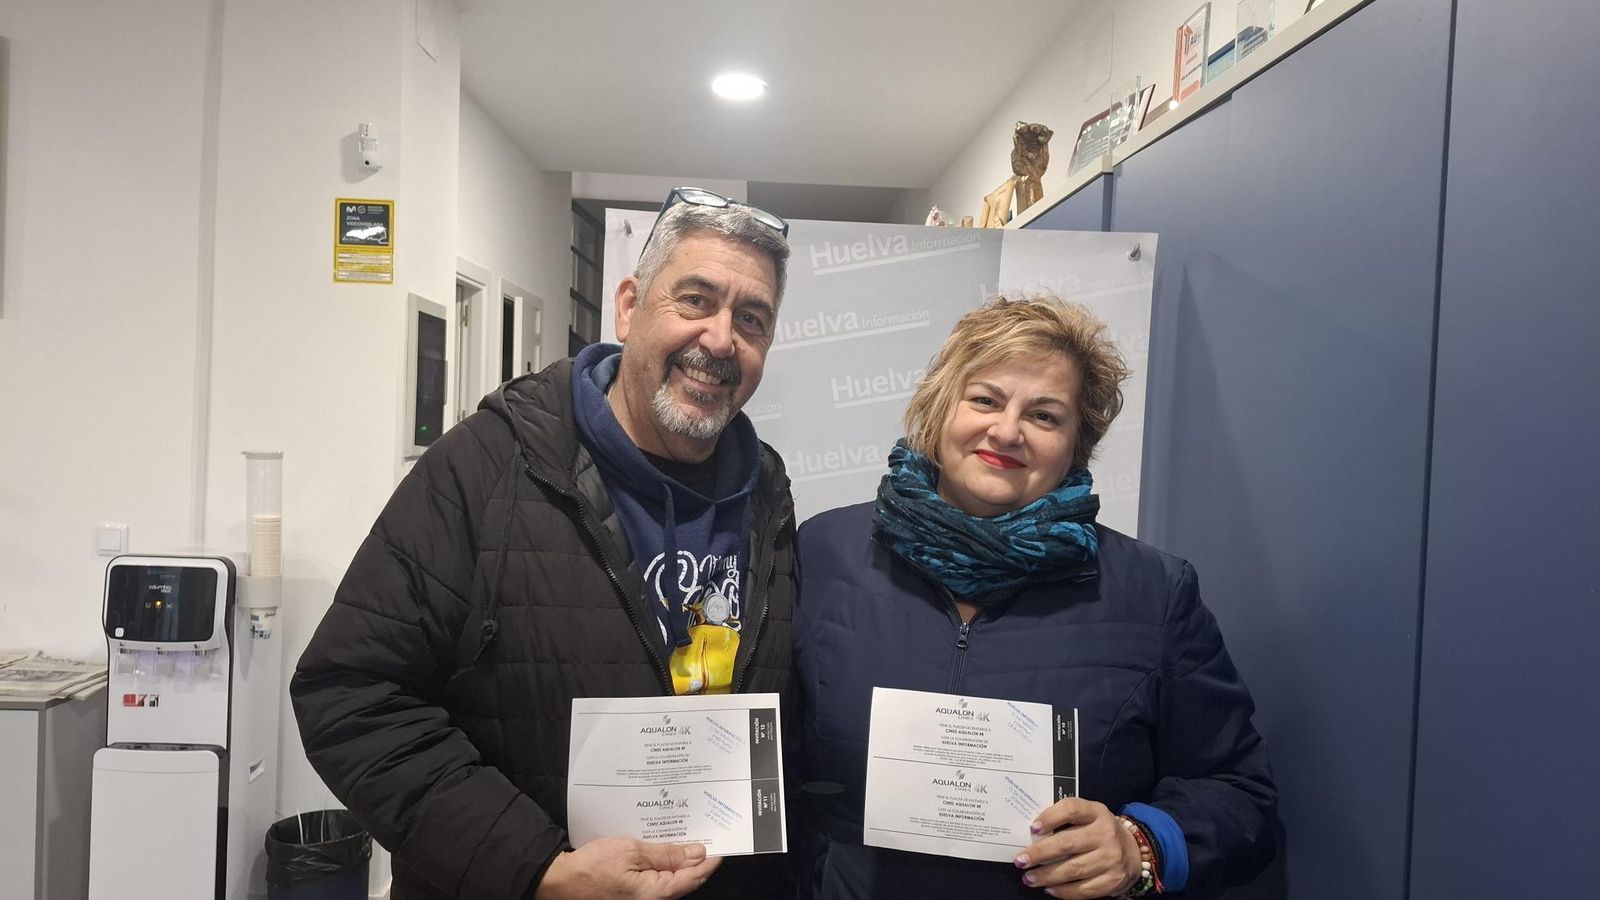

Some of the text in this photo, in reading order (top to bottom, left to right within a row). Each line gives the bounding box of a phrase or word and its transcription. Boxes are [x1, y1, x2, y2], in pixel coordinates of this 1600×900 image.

[809, 231, 981, 269] Huelva Información
[861, 309, 930, 330] Información
[782, 443, 882, 476] Huelva
[935, 707, 974, 717] AQUALON
[640, 726, 677, 734] AQUALON
[932, 778, 972, 788] AQUALON
[636, 799, 674, 808] AQUALON
